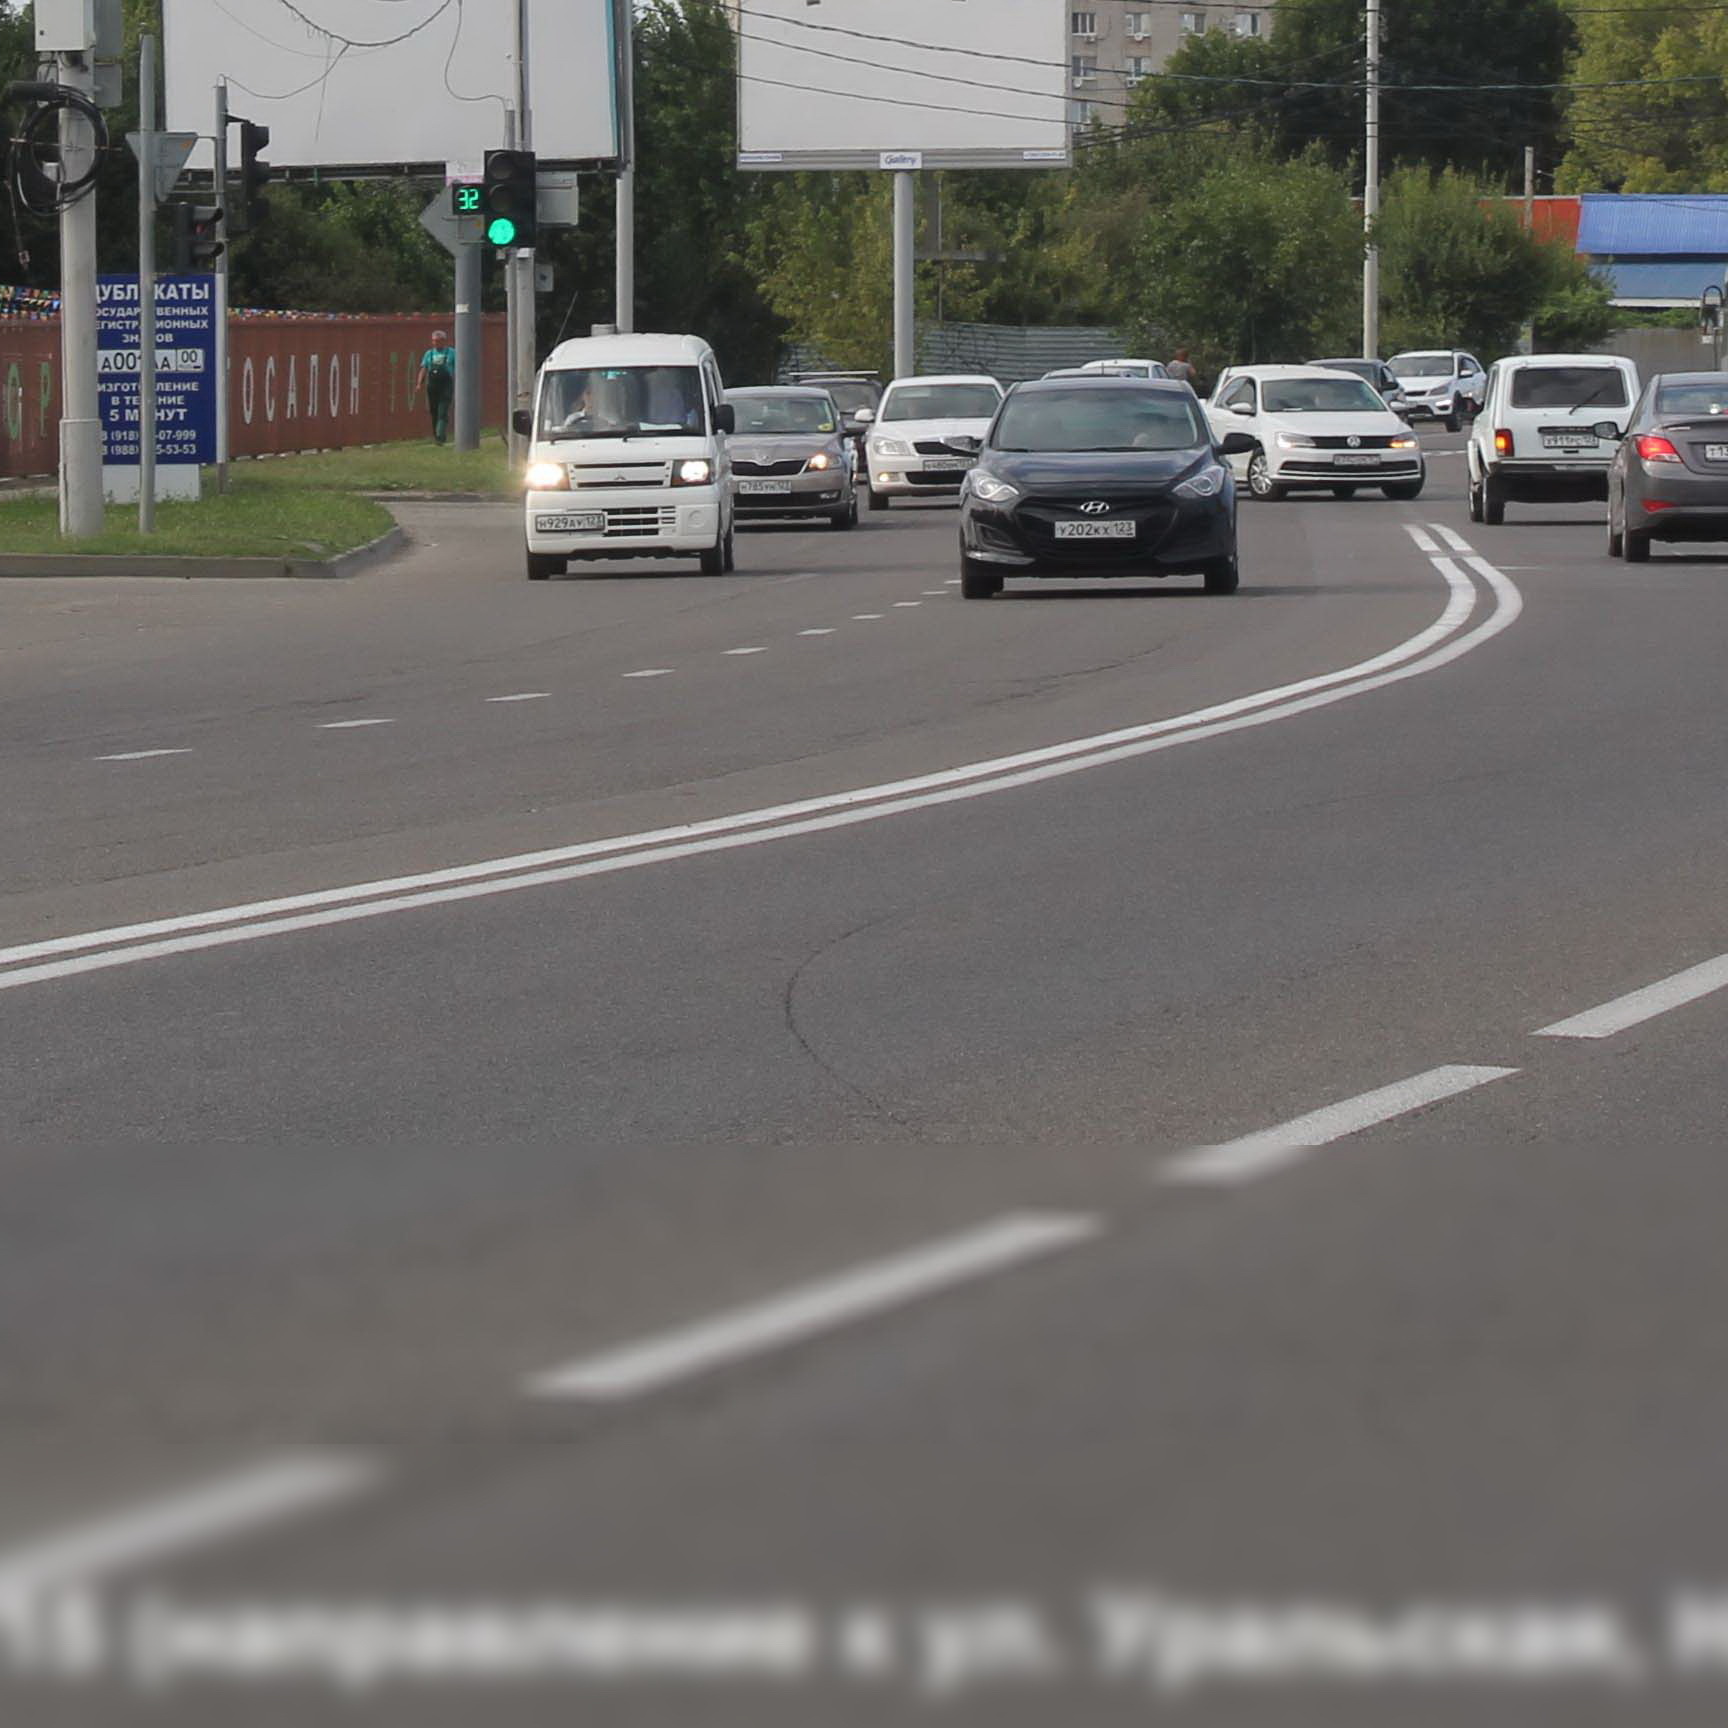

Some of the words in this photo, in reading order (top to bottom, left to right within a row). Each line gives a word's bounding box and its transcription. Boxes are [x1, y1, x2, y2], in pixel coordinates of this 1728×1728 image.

[458, 188, 480, 210] 32
[96, 283, 210, 305] УБЛКАТЫ
[111, 396, 121, 406] В
[109, 408, 120, 422] 5
[124, 408, 188, 422] МНУТ
